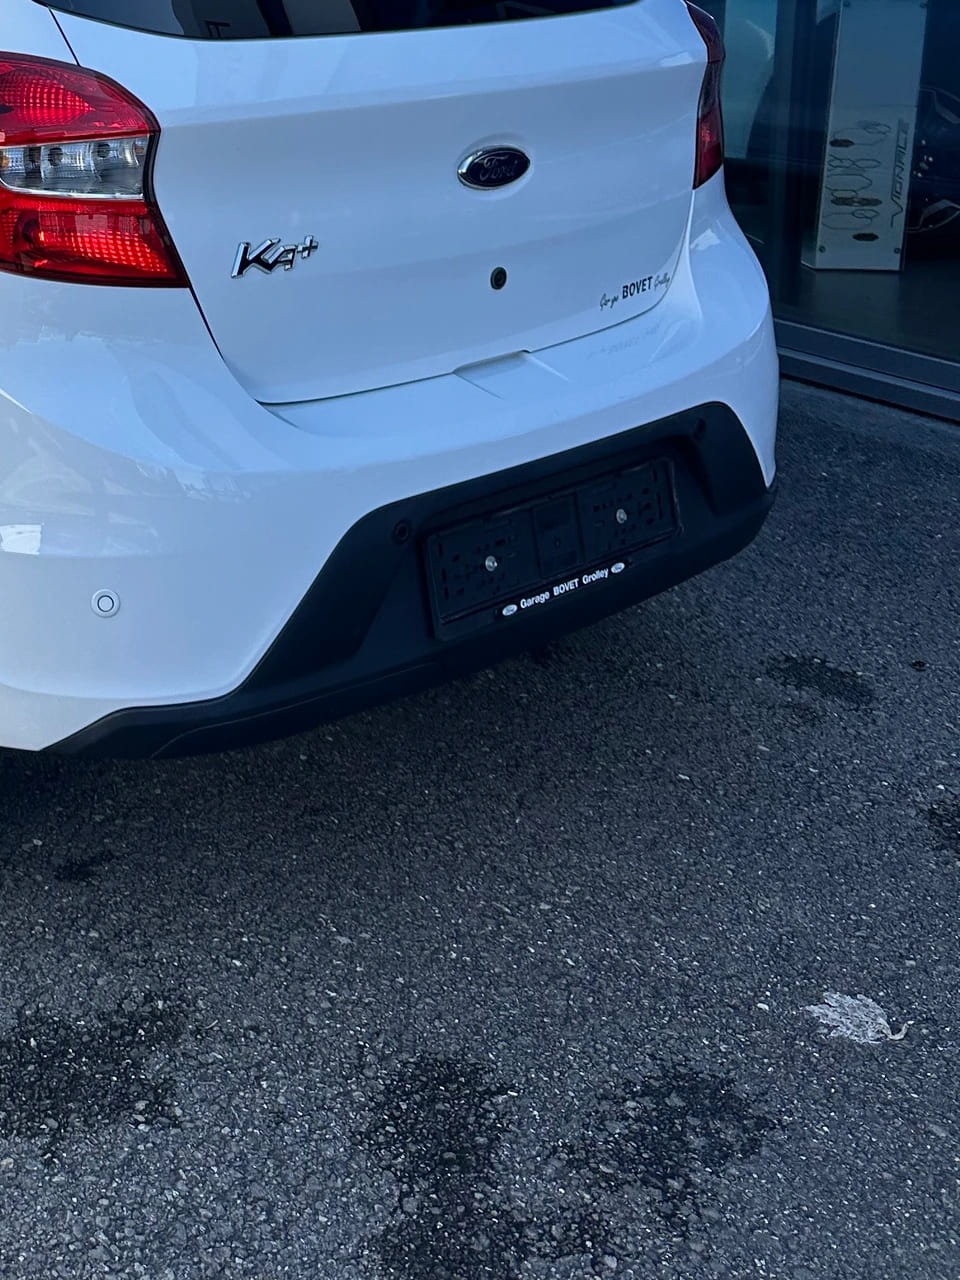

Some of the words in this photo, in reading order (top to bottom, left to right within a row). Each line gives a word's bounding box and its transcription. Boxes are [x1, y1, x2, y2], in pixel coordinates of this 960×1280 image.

[622, 275, 653, 300] BOVET
[520, 591, 550, 609] Garage
[553, 578, 580, 596] BOVET
